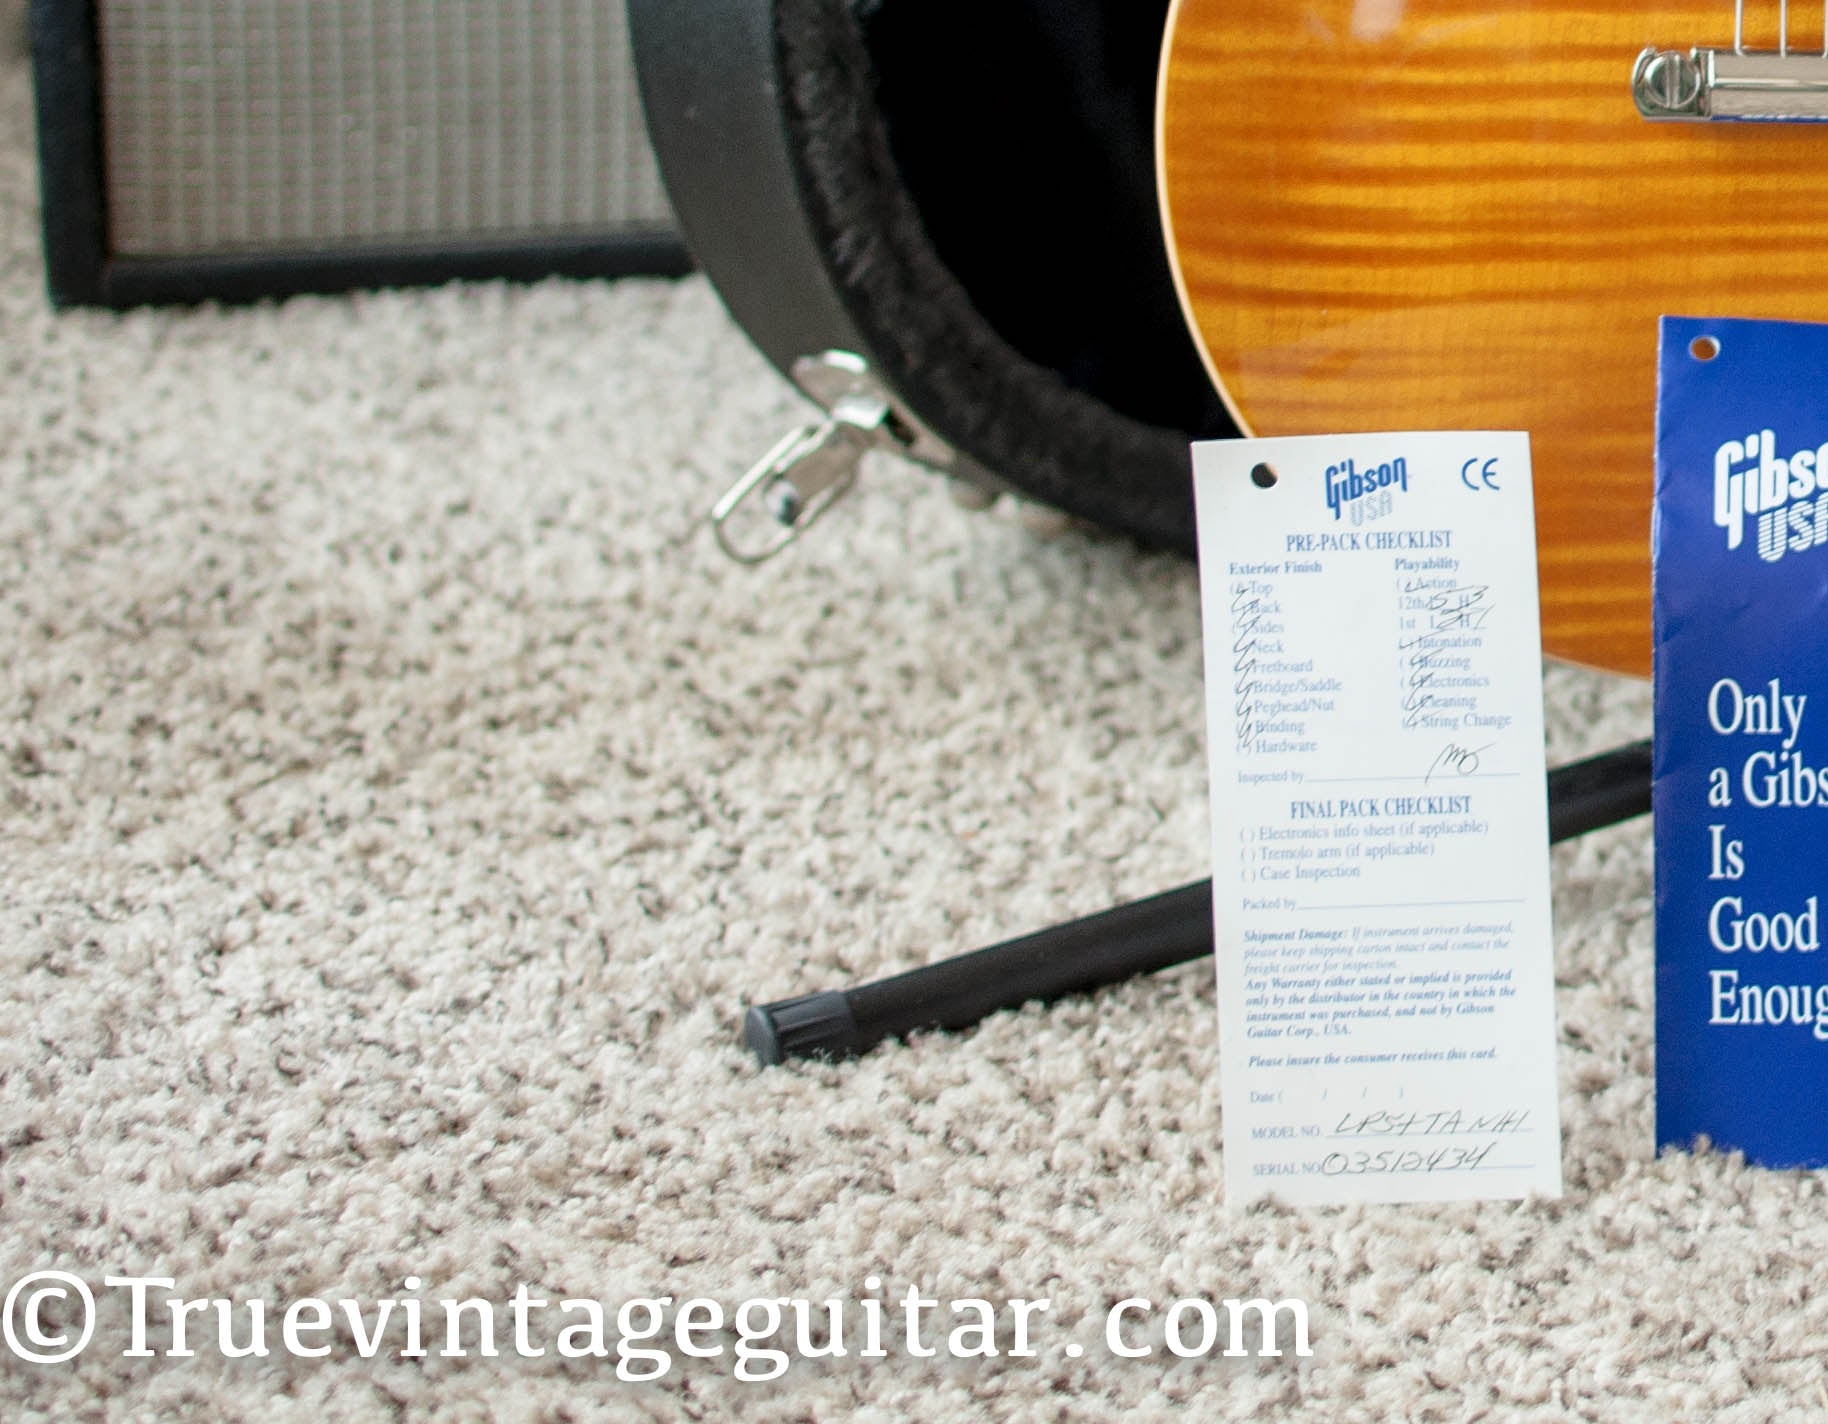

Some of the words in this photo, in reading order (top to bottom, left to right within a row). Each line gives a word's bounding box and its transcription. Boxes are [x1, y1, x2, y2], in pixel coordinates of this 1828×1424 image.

[1325, 457, 1407, 520] Gibson
[1351, 490, 1393, 526] USA
[1286, 532, 1361, 552] PRE-PACK
[1365, 529, 1452, 550] CHECKLIST
[1229, 562, 1280, 575] Exterior
[1284, 560, 1323, 574] Finish
[1394, 556, 1460, 572] Playability
[1249, 580, 1273, 598] Top
[1416, 577, 1457, 589] Action
[1252, 640, 1285, 654] Neck
[1418, 635, 1482, 649] Intonation
[1252, 659, 1313, 674] Fretboard
[1254, 677, 1343, 695] Bridge/Saddle
[1254, 697, 1336, 716] Peghead/Nut
[1707, 677, 1808, 748] Only
[1256, 720, 1306, 736] Binding
[1421, 714, 1459, 730] String
[1464, 712, 1513, 730] Change
[1256, 739, 1318, 753] Hardware
[1708, 766, 1732, 807] a
[1290, 799, 1337, 819] FINAL
[1339, 797, 1380, 817] PACK
[1384, 795, 1472, 816] CHECKLIST
[1259, 825, 1329, 840] Electronics
[1334, 823, 1360, 838] info
[1364, 823, 1395, 837] sheet
[1399, 821, 1415, 837] (if
[1419, 819, 1489, 838] applicable)
[1260, 845, 1313, 861] Tremolo
[1317, 847, 1342, 859] arm
[1346, 842, 1361, 859] (if
[1365, 841, 1435, 861] applicable)
[1708, 824, 1745, 880] Is
[1260, 865, 1291, 881] Case
[1296, 863, 1361, 882] Inspection
[1708, 895, 1820, 953] Good
[1456, 1002, 1495, 1015] Gibson
[1249, 1054, 1283, 1067] Please
[1286, 1054, 1320, 1066] insure
[1324, 1052, 1341, 1064] the
[1344, 1053, 1399, 1064] consumer
[1252, 1126, 1297, 1138] MODEL
[1321, 1141, 1498, 1176] 03512434
[1253, 1162, 1297, 1175] SERIAL
